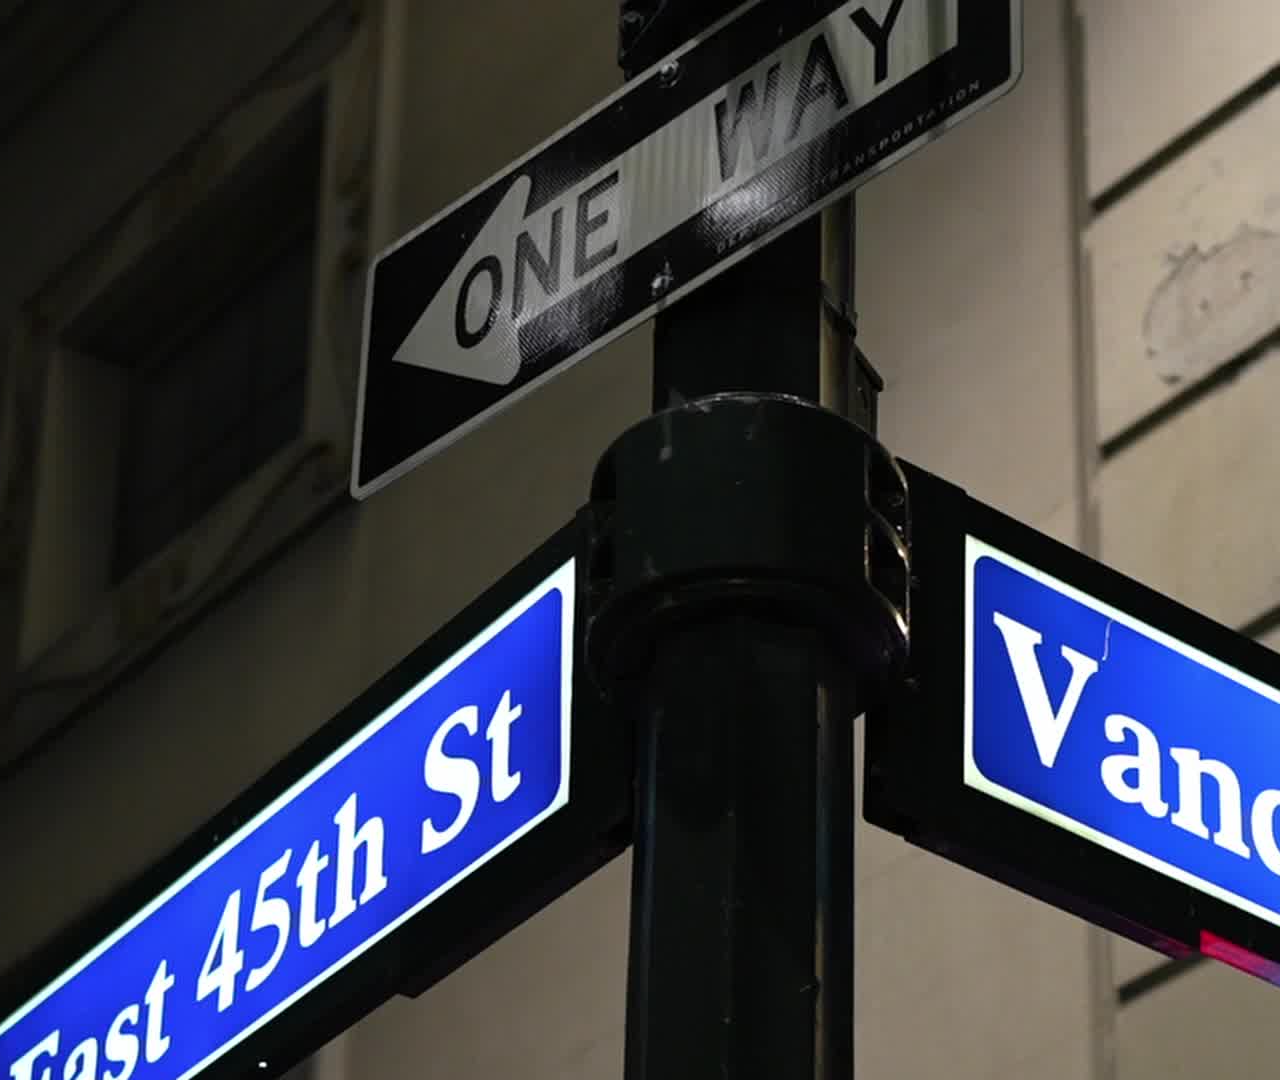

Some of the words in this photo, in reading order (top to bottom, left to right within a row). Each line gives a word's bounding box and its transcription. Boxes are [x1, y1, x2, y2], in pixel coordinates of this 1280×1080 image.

[455, 170, 620, 349] ONE
[714, 0, 907, 183] WAY
[195, 792, 388, 1012] 45th
[421, 689, 522, 854] St
